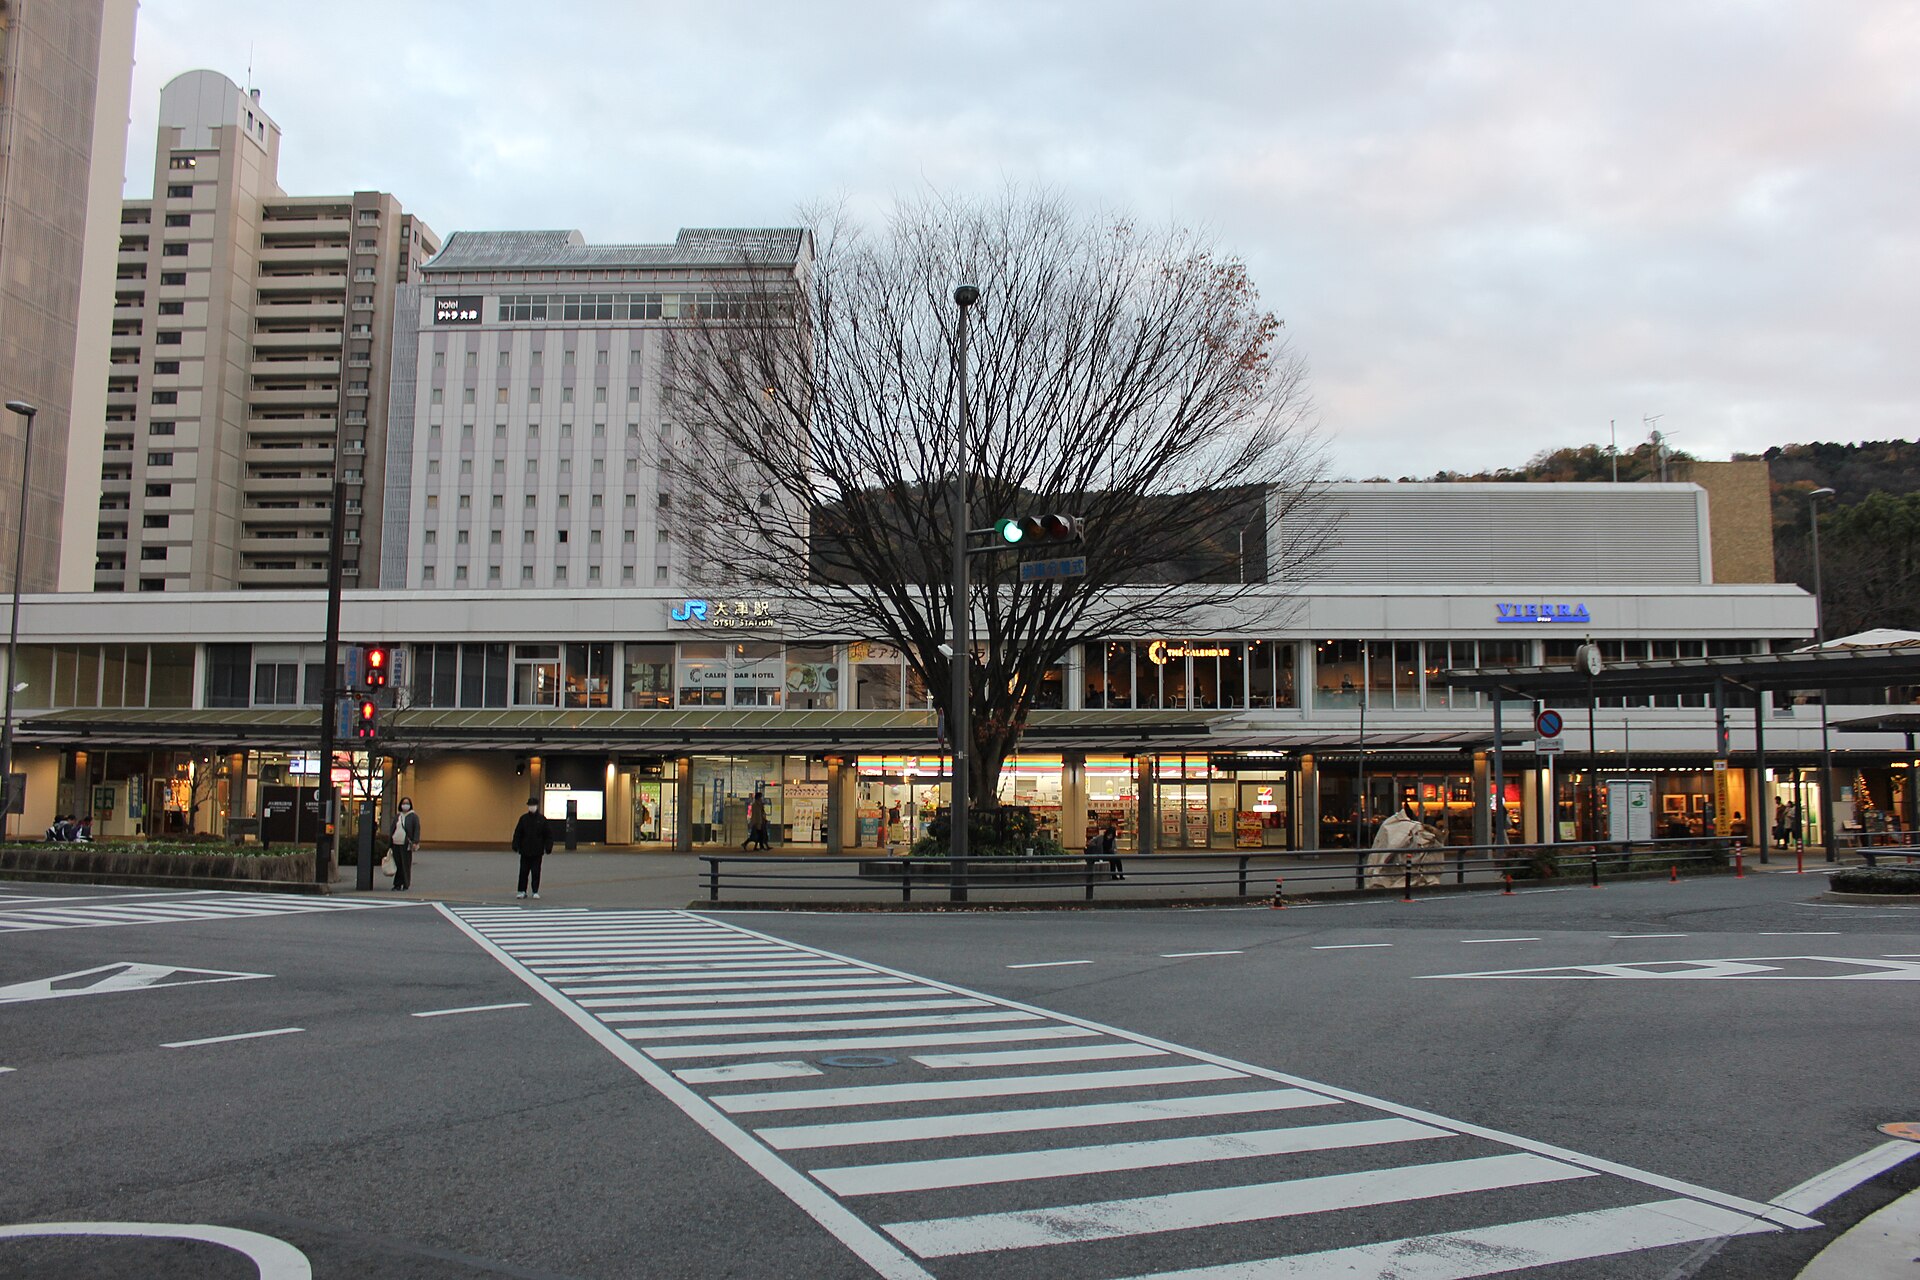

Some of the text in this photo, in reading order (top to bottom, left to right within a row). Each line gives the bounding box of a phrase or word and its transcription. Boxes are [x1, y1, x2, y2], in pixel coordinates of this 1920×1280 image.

[438, 300, 458, 309] hotel
[672, 600, 707, 620] JR
[714, 601, 769, 616] 大津駅
[1496, 603, 1591, 617] VIERRA
[1167, 649, 1230, 657] THE CALENDAR
